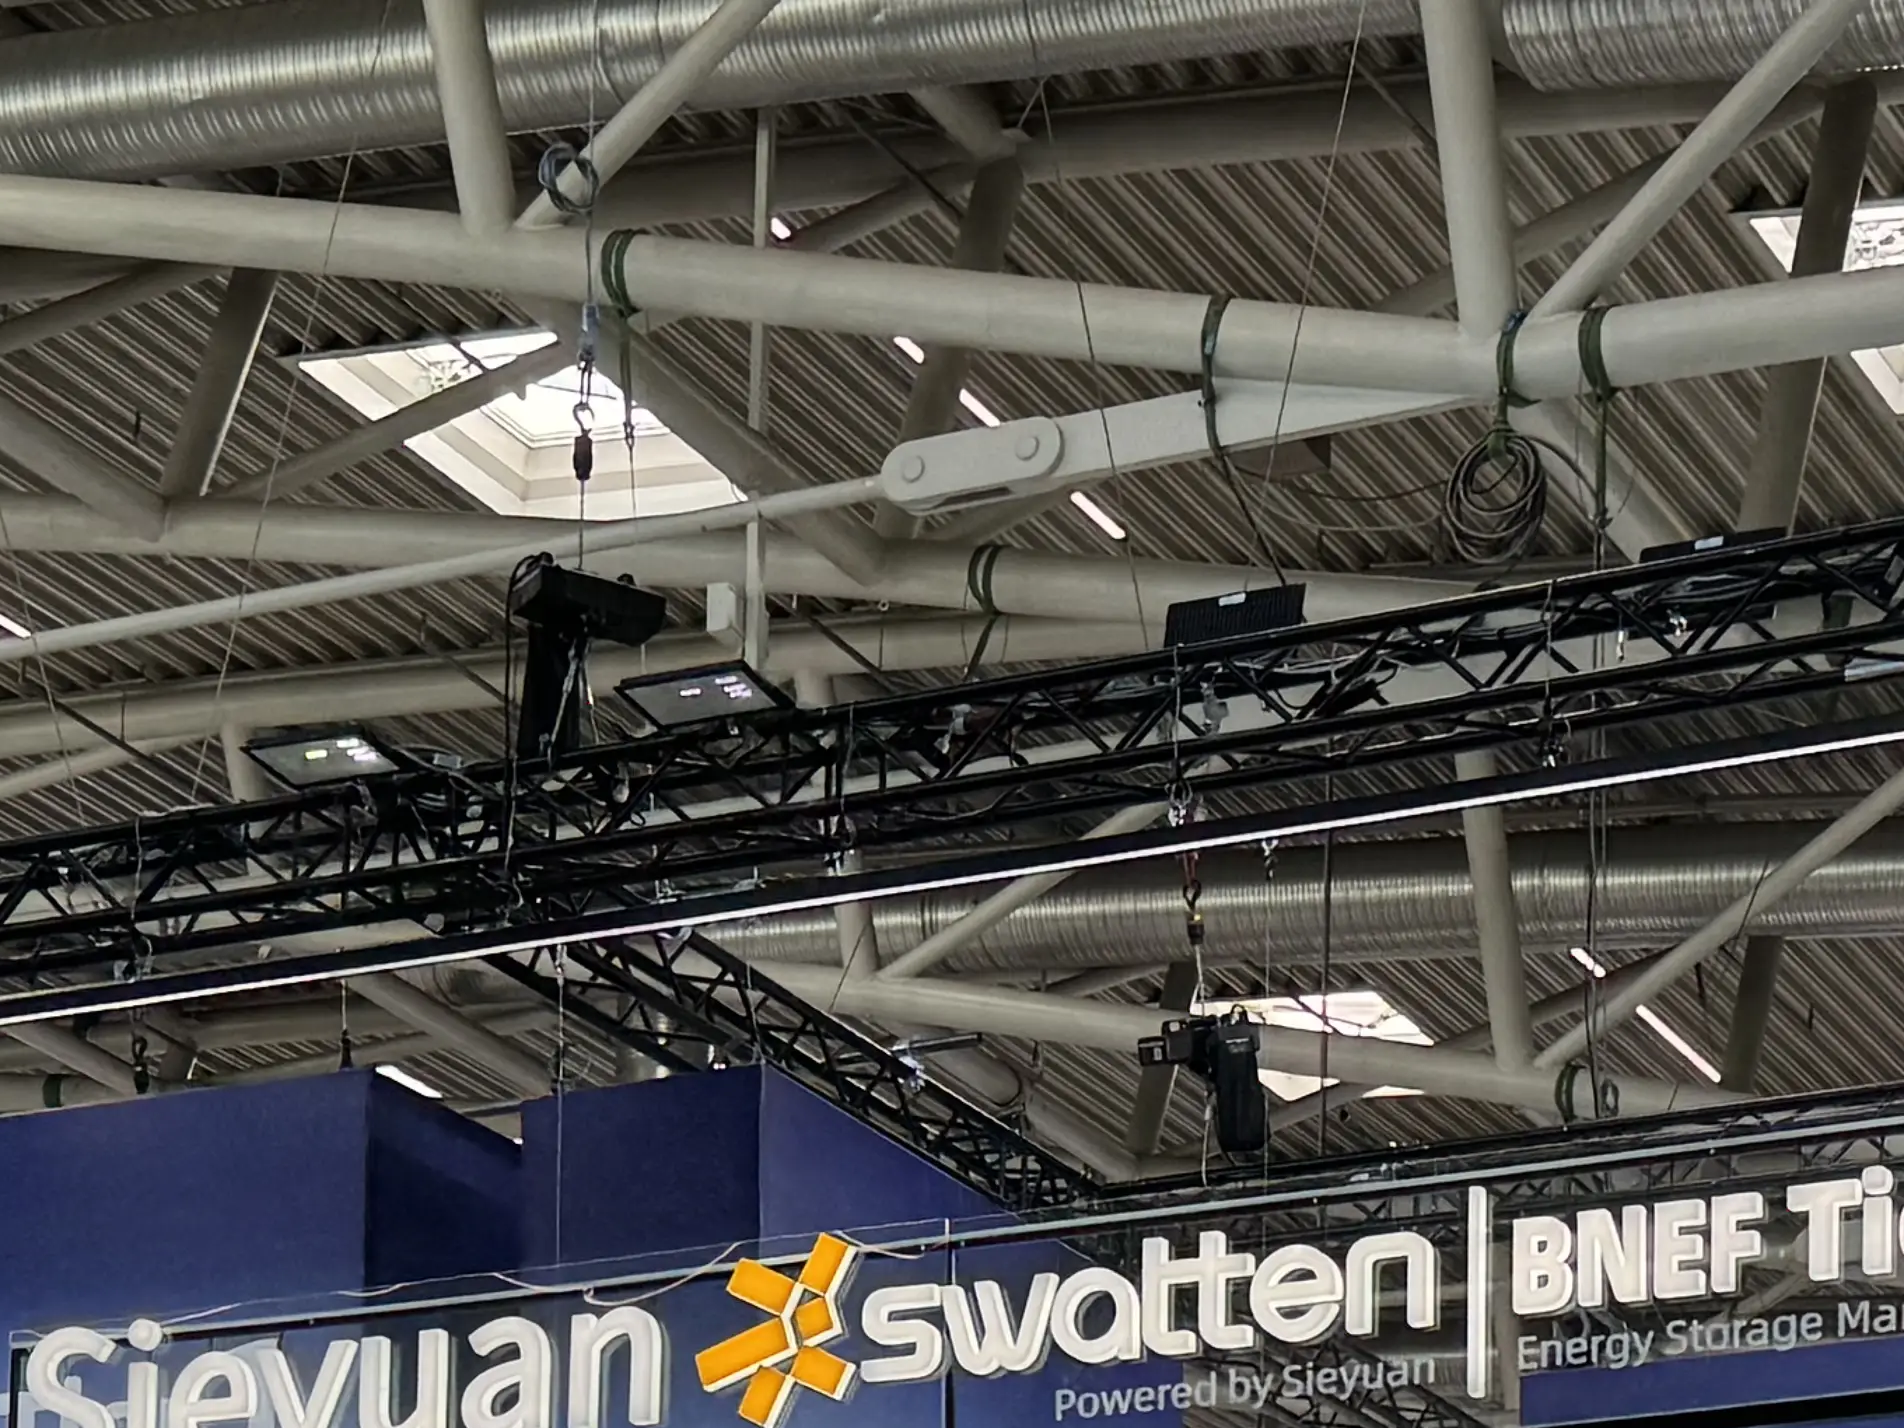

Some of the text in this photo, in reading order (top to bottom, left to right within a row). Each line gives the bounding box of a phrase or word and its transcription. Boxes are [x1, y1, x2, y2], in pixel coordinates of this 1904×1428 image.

[858, 1228, 1442, 1384] swatten
[1512, 1197, 1776, 1315] BNEF
[1516, 1327, 1659, 1376] Energy
[1665, 1310, 1826, 1356] Storage
[1053, 1354, 1436, 1421] Powered by Sieyuan
